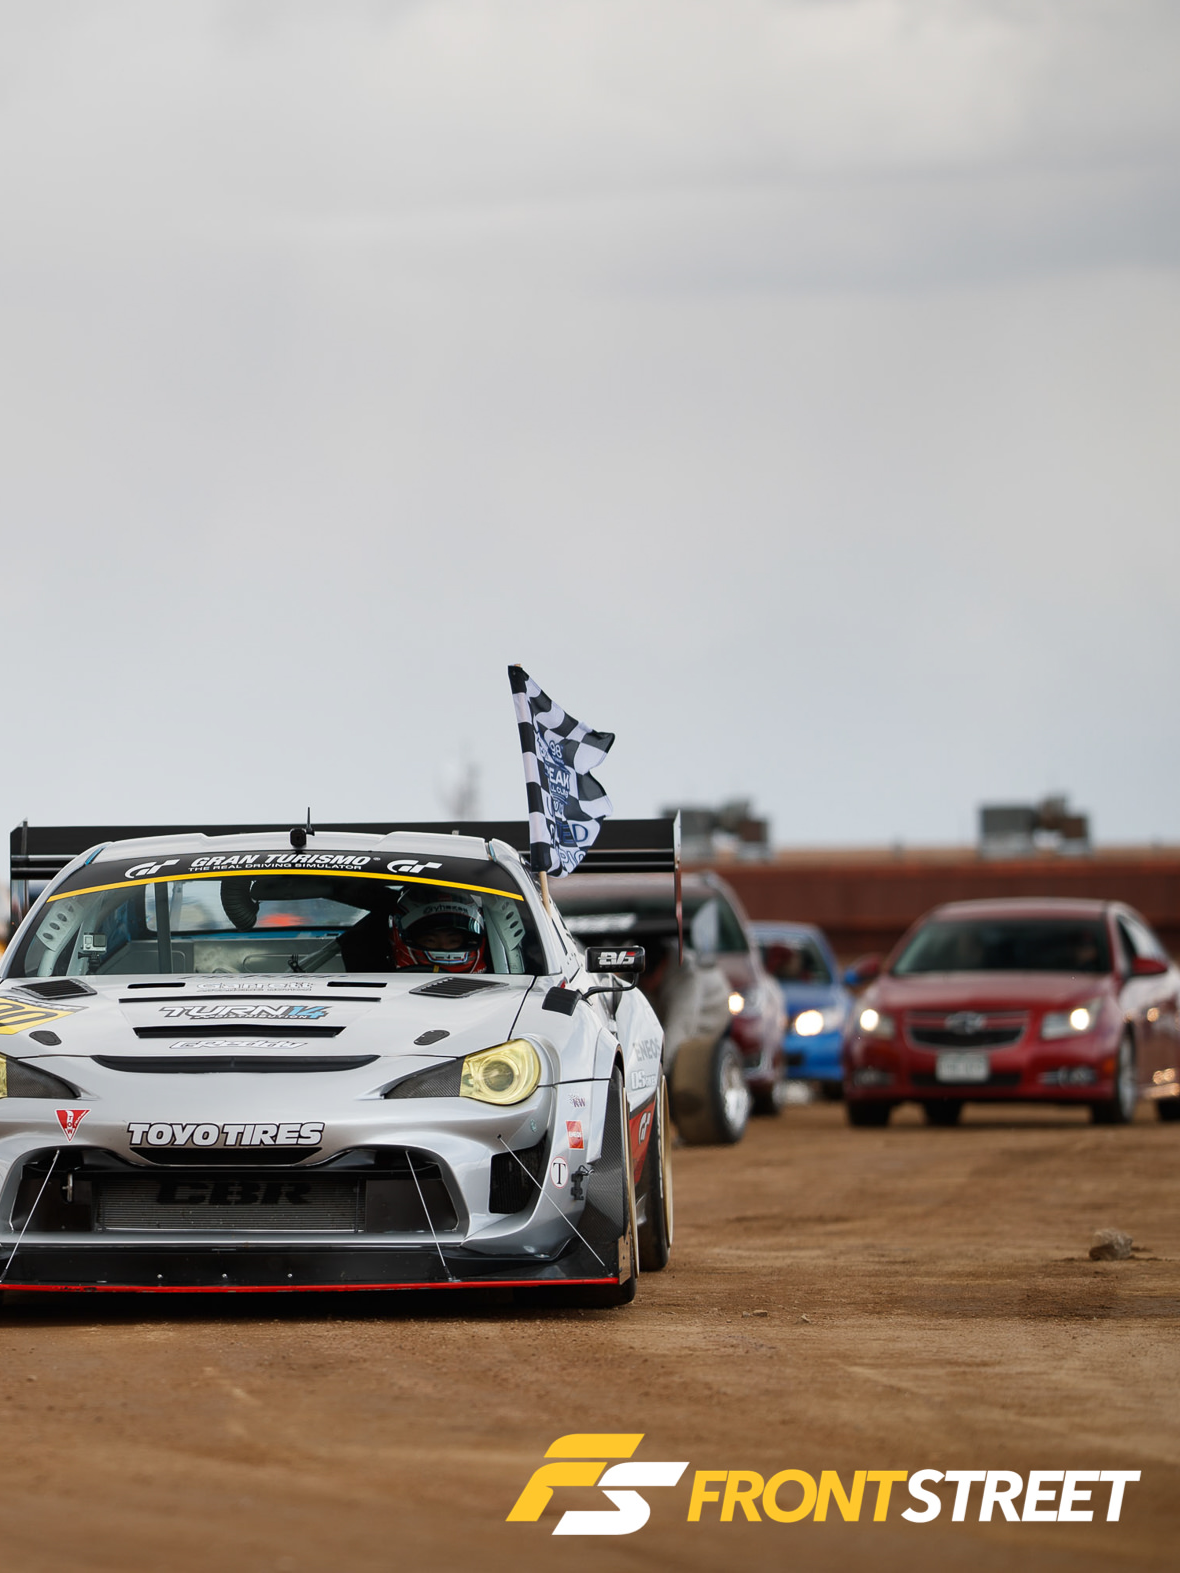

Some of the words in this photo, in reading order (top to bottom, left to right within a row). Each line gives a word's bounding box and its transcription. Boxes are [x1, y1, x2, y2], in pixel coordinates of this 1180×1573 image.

[191, 855, 260, 867] GRAN
[265, 854, 371, 865] TURISMO
[127, 1123, 220, 1146] TOYO
[222, 1122, 324, 1146] TIRES
[156, 1178, 313, 1205] CBR
